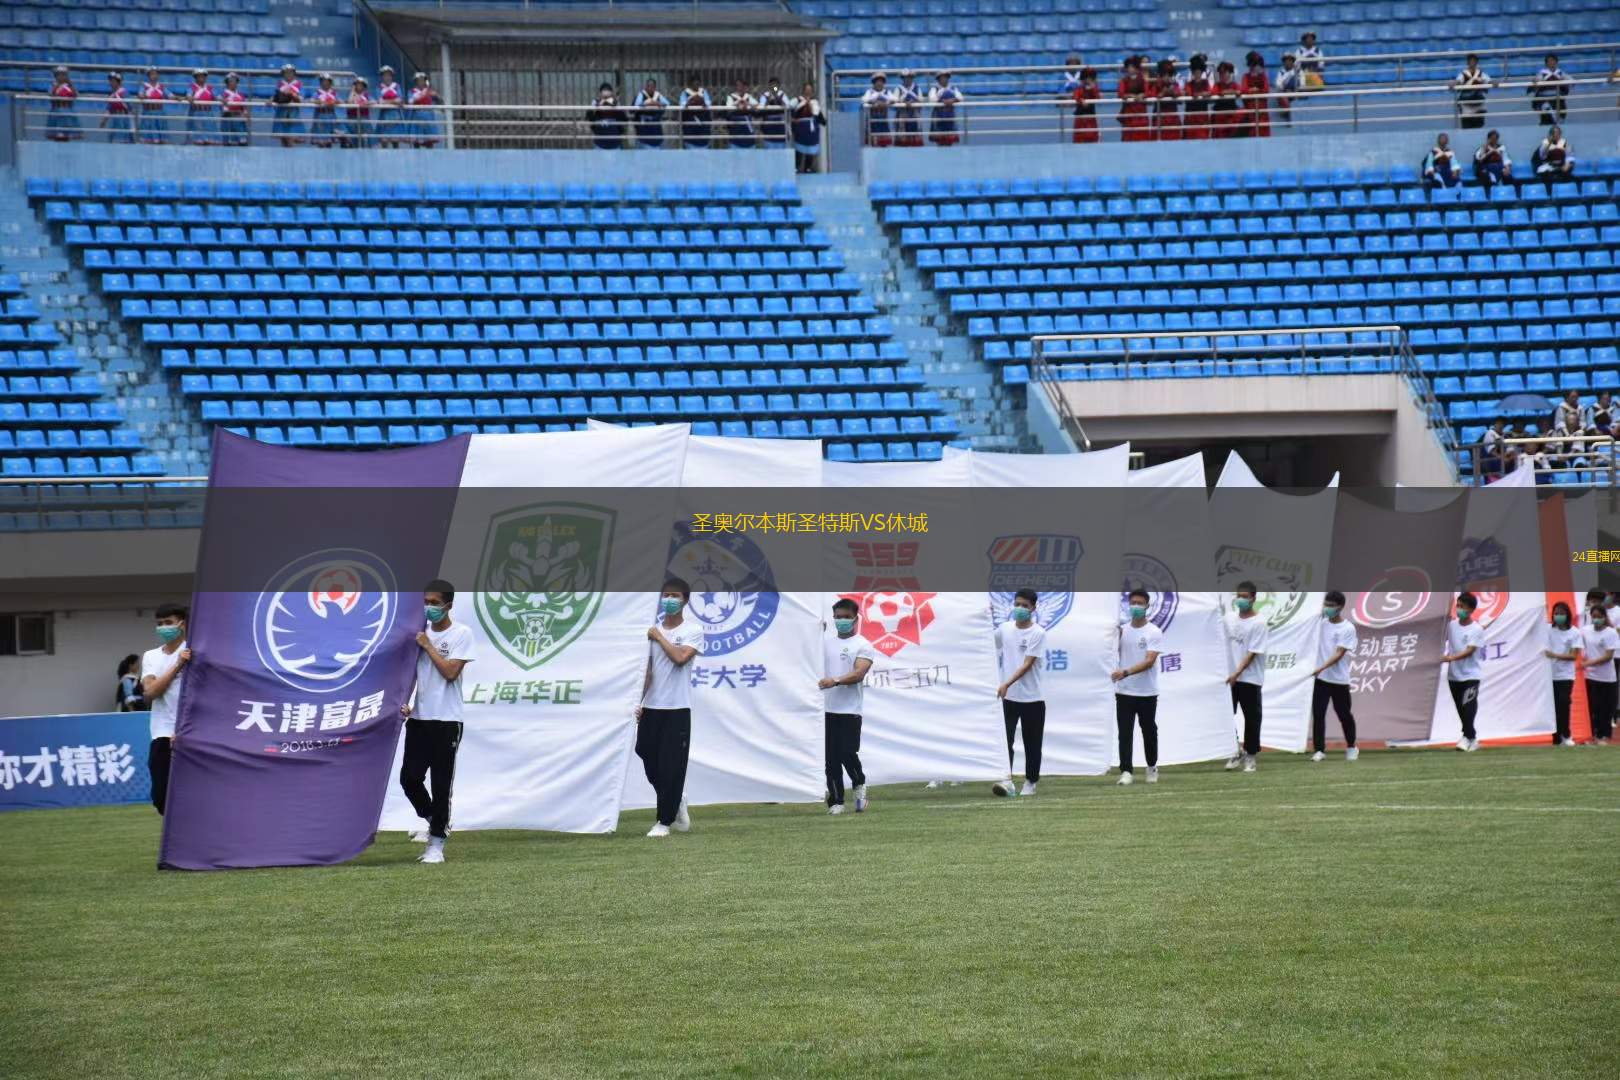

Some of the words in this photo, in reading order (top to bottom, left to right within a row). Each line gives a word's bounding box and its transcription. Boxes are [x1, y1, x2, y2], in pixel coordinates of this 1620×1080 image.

[703, 610, 771, 652] OOTBALL
[1348, 656, 1414, 674] MART
[463, 680, 584, 705] 上海华正
[0, 743, 136, 790] 你才精彩
